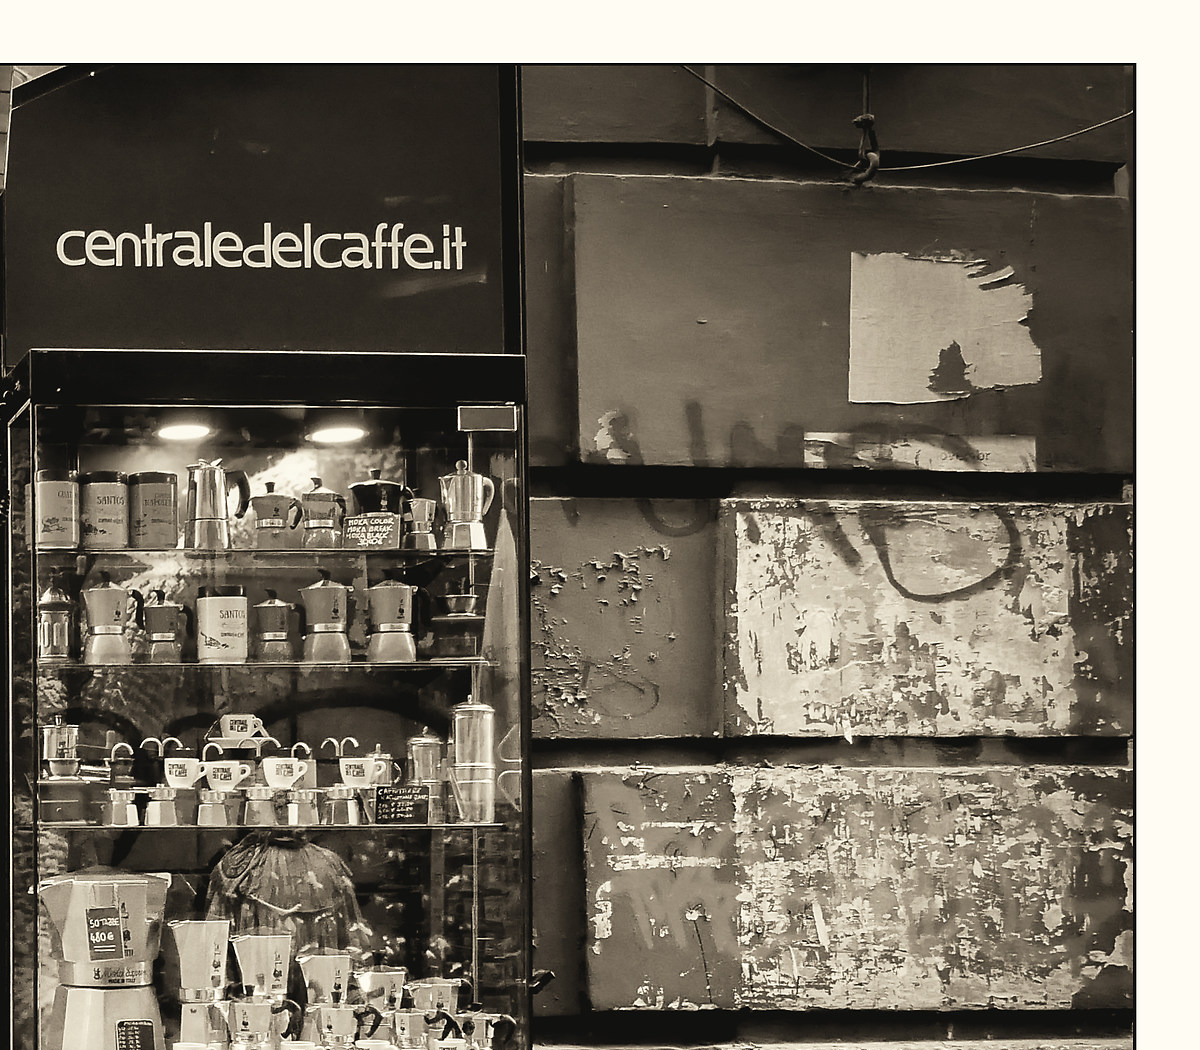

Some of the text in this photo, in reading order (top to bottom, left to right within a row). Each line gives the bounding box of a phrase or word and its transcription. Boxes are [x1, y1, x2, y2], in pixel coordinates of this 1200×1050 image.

[56, 222, 467, 270] centraledelcaffe.it
[97, 495, 125, 506] SANTOS
[219, 609, 246, 619] SANTOS
[89, 919, 100, 928] 50
